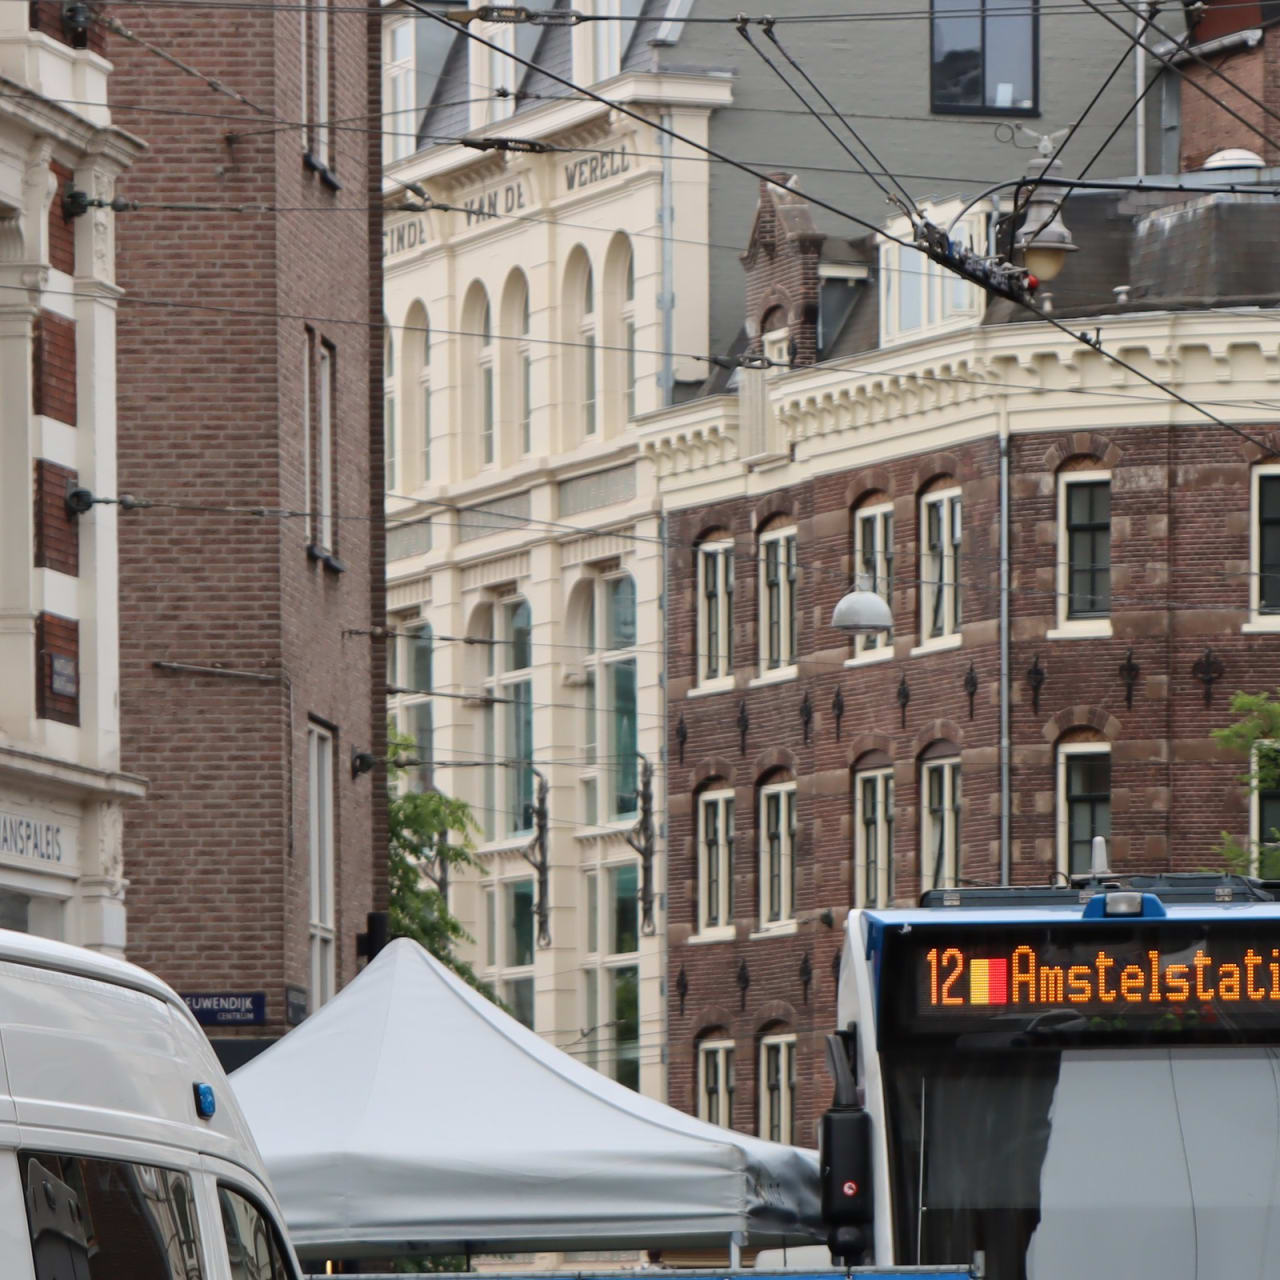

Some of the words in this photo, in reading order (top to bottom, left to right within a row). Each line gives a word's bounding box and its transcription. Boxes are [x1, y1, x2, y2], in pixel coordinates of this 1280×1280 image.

[464, 191, 498, 226] VAN
[505, 183, 524, 213] DE
[927, 947, 964, 1006] 12
[184, 996, 254, 1011] EUWENDIJK
